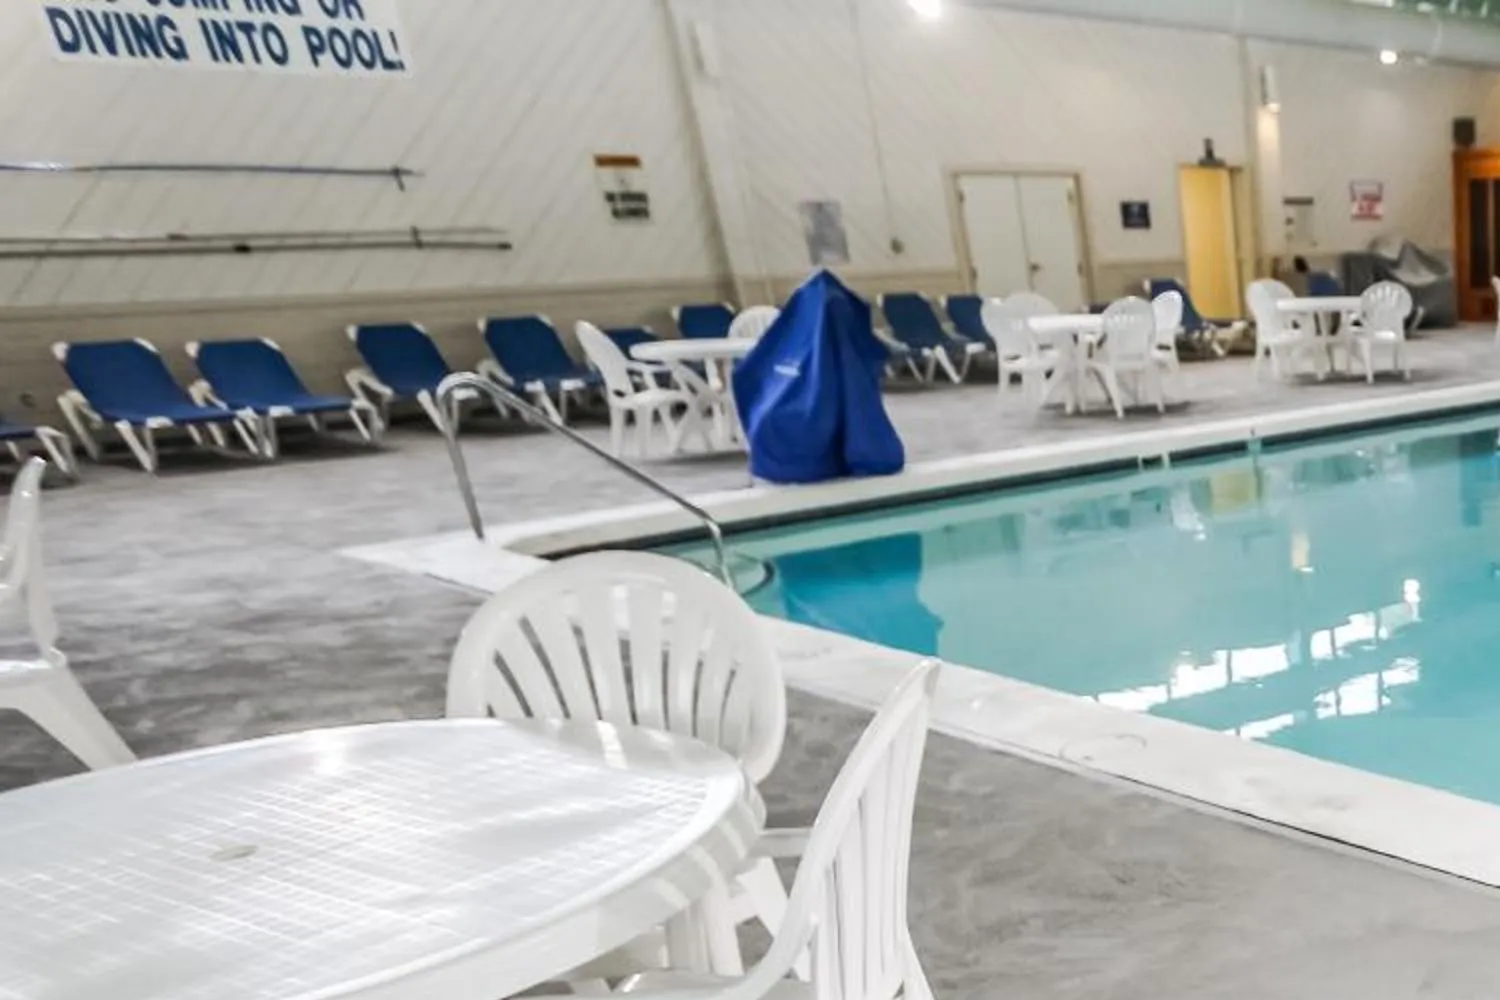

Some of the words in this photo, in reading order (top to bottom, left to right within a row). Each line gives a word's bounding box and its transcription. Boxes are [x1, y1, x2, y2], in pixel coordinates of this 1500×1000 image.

[45, 7, 190, 61] DIVING
[198, 18, 289, 66] INTO
[300, 25, 406, 71] POOL!
